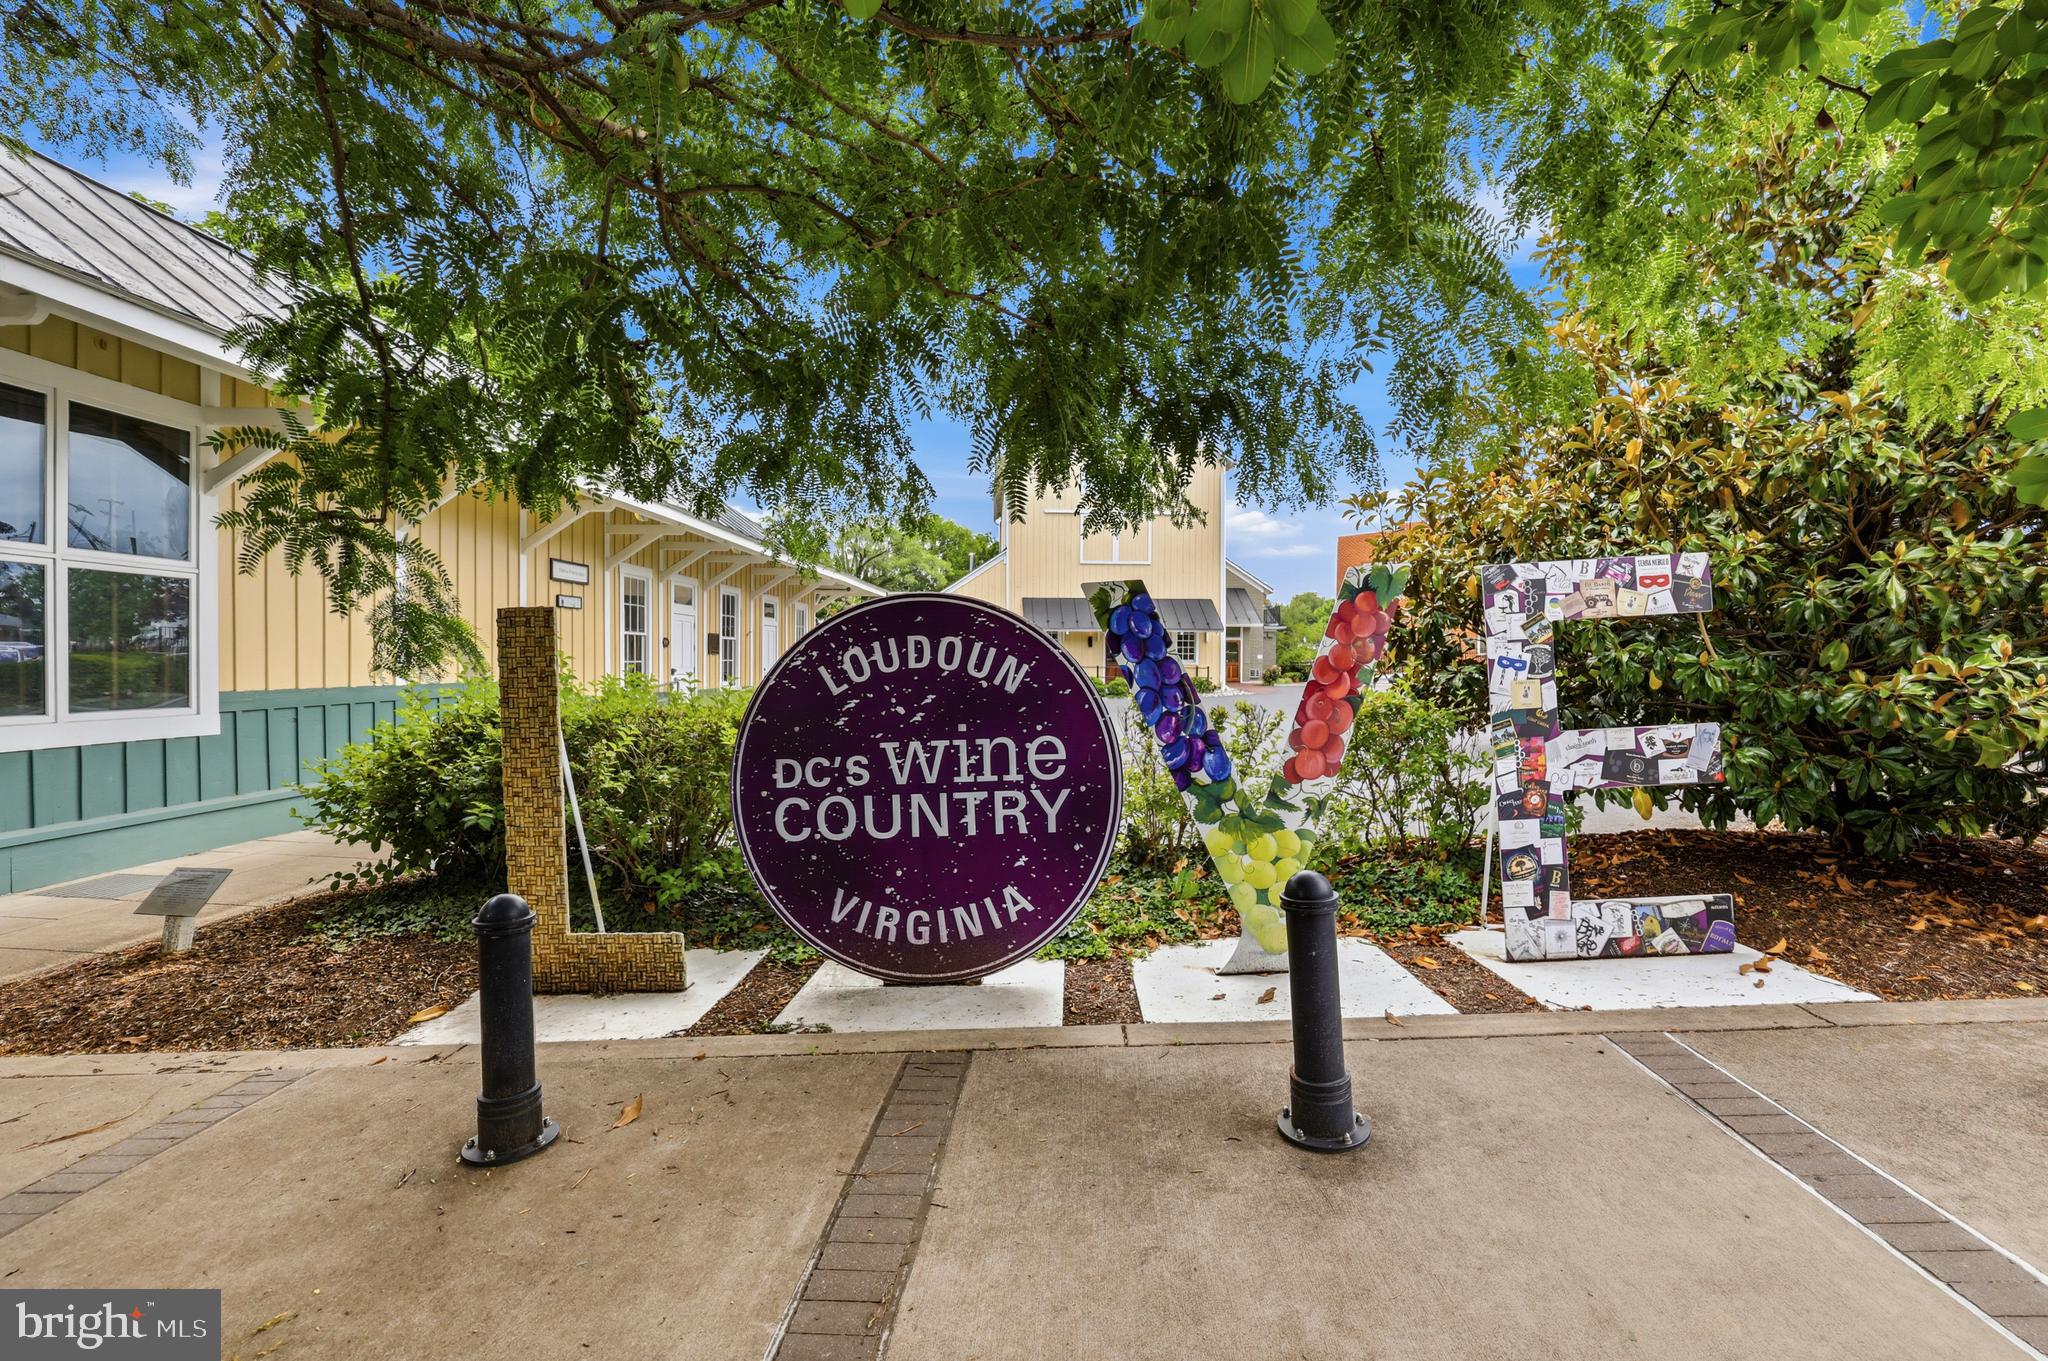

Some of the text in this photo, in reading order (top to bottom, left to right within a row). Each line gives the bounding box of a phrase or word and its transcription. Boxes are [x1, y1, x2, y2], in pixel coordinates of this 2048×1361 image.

[818, 635, 1030, 696] LOUDOUN
[774, 788, 1071, 842] COUNTRY
[830, 885, 1035, 945] VIRGINIA
